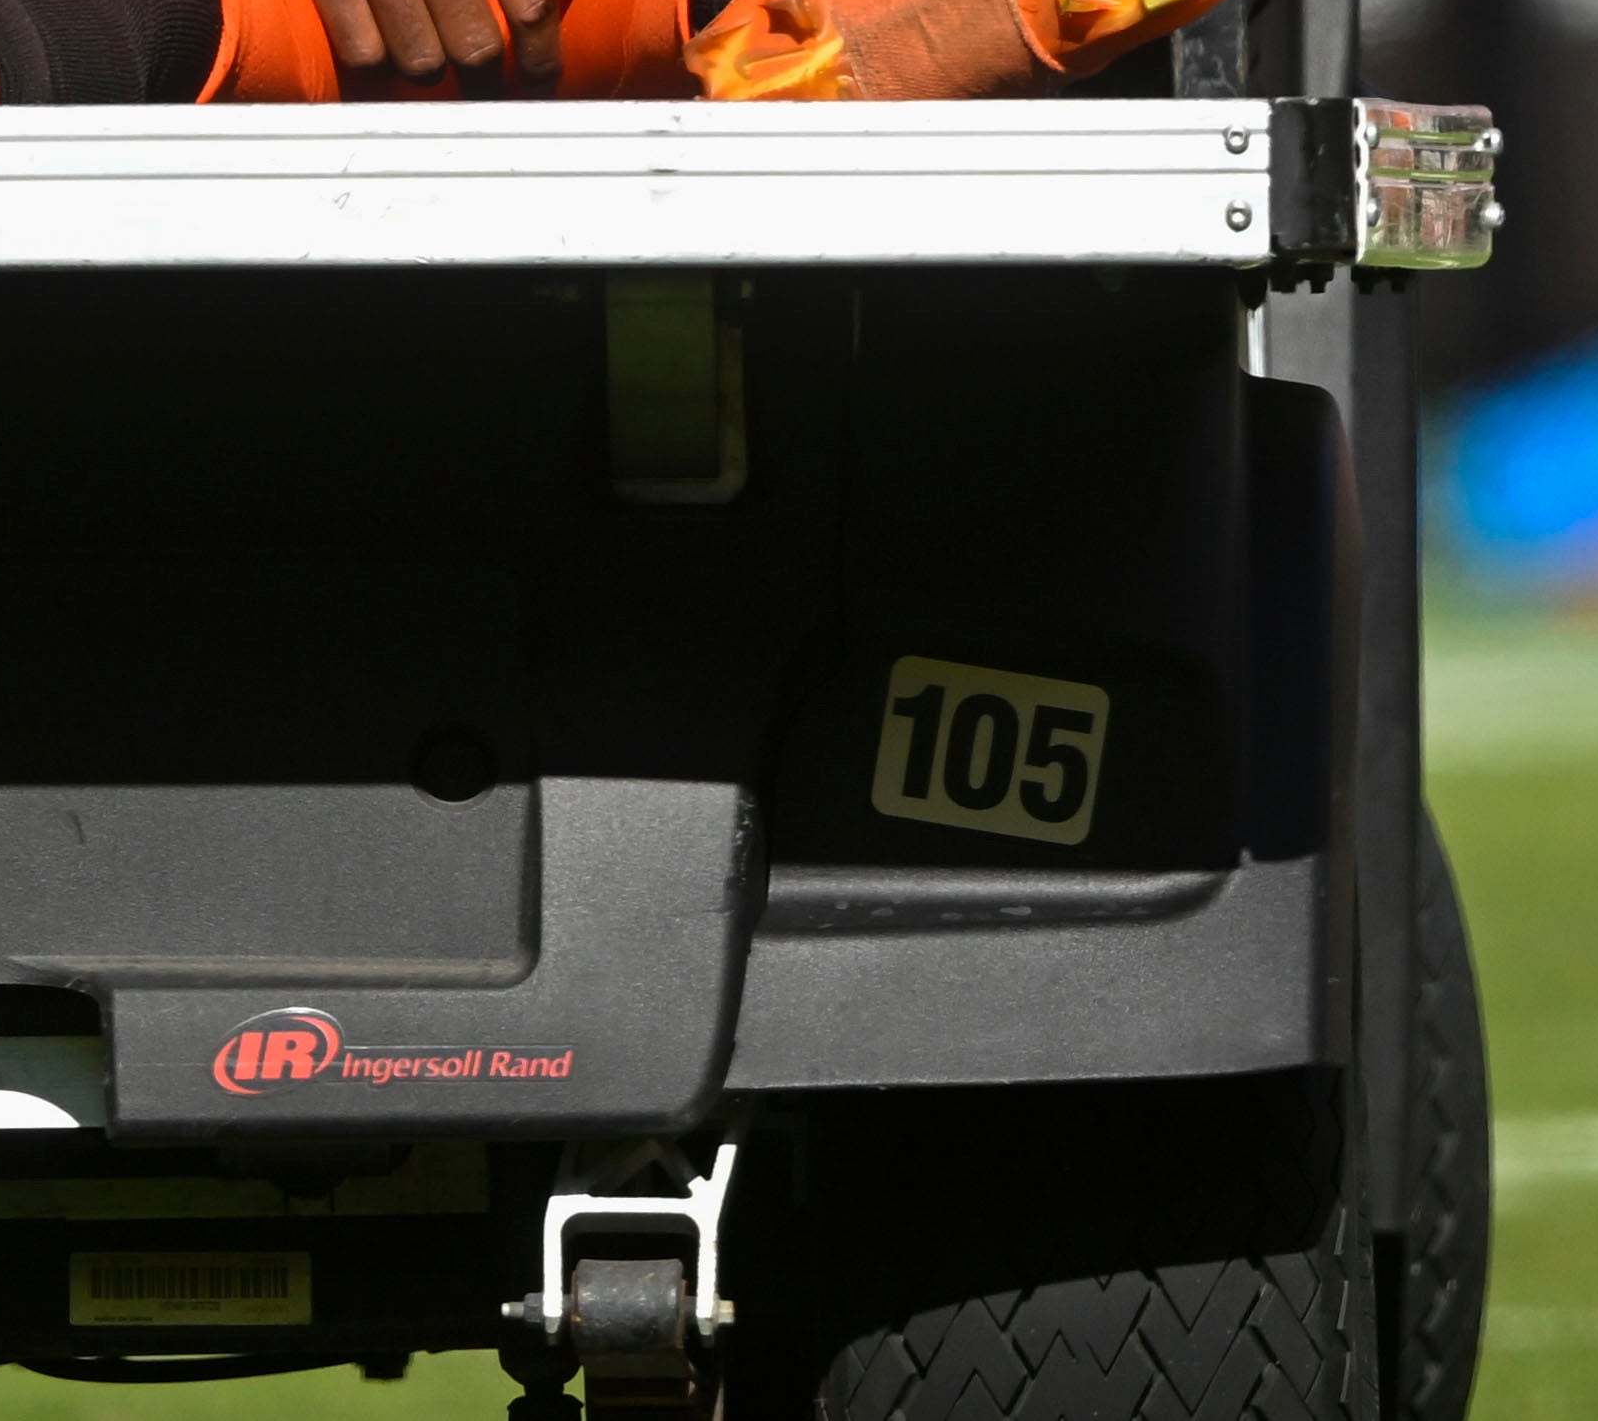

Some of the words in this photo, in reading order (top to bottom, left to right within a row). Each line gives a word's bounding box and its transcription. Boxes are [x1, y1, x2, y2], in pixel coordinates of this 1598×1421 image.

[893, 684, 1095, 823] 105
[233, 1031, 319, 1080] IR
[341, 1048, 482, 1085] Ingersoll
[488, 1049, 574, 1079] Rand
